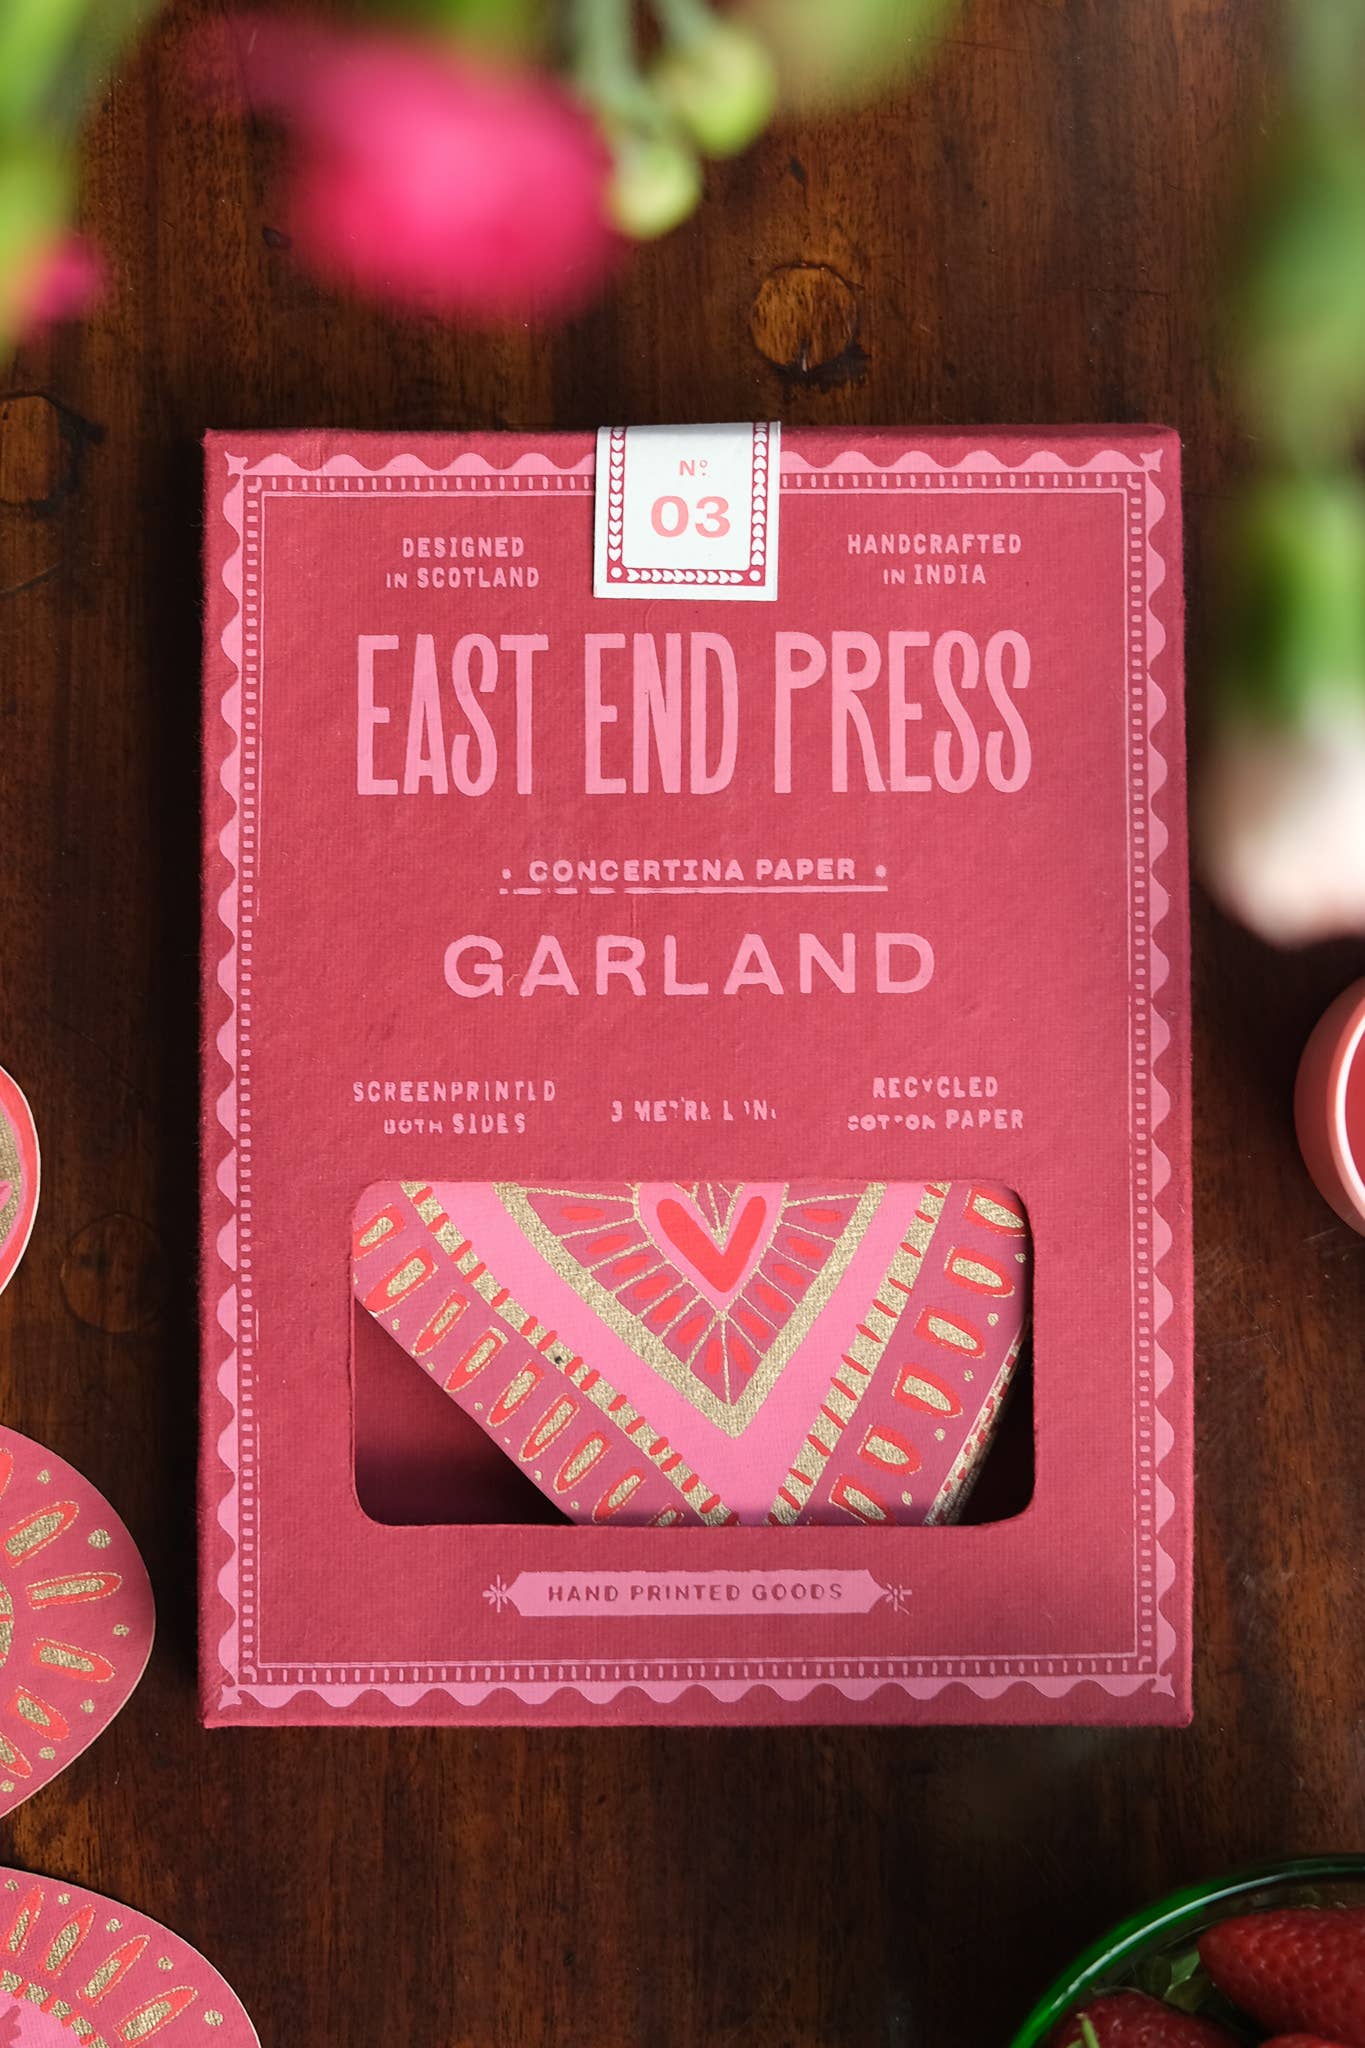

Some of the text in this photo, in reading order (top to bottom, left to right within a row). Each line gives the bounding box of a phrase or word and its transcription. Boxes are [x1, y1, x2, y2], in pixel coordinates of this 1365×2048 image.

[651, 495, 731, 538] 03
[402, 536, 525, 558] DESIGNED
[847, 533, 1022, 555] HANDCRAFTED
[386, 566, 540, 589] IN SCOTLAND
[883, 563, 986, 585] IN INDIA
[357, 629, 1032, 797] EAST END PRESS
[528, 857, 856, 882] CONCERTINA PAPER
[443, 932, 936, 998] GARLAND
[872, 1075, 999, 1098] RECYCLED
[452, 1111, 527, 1135] SIDES
[945, 1107, 1024, 1130] PAPER
[548, 1582, 843, 1603] HAND PRINTED GOODS
